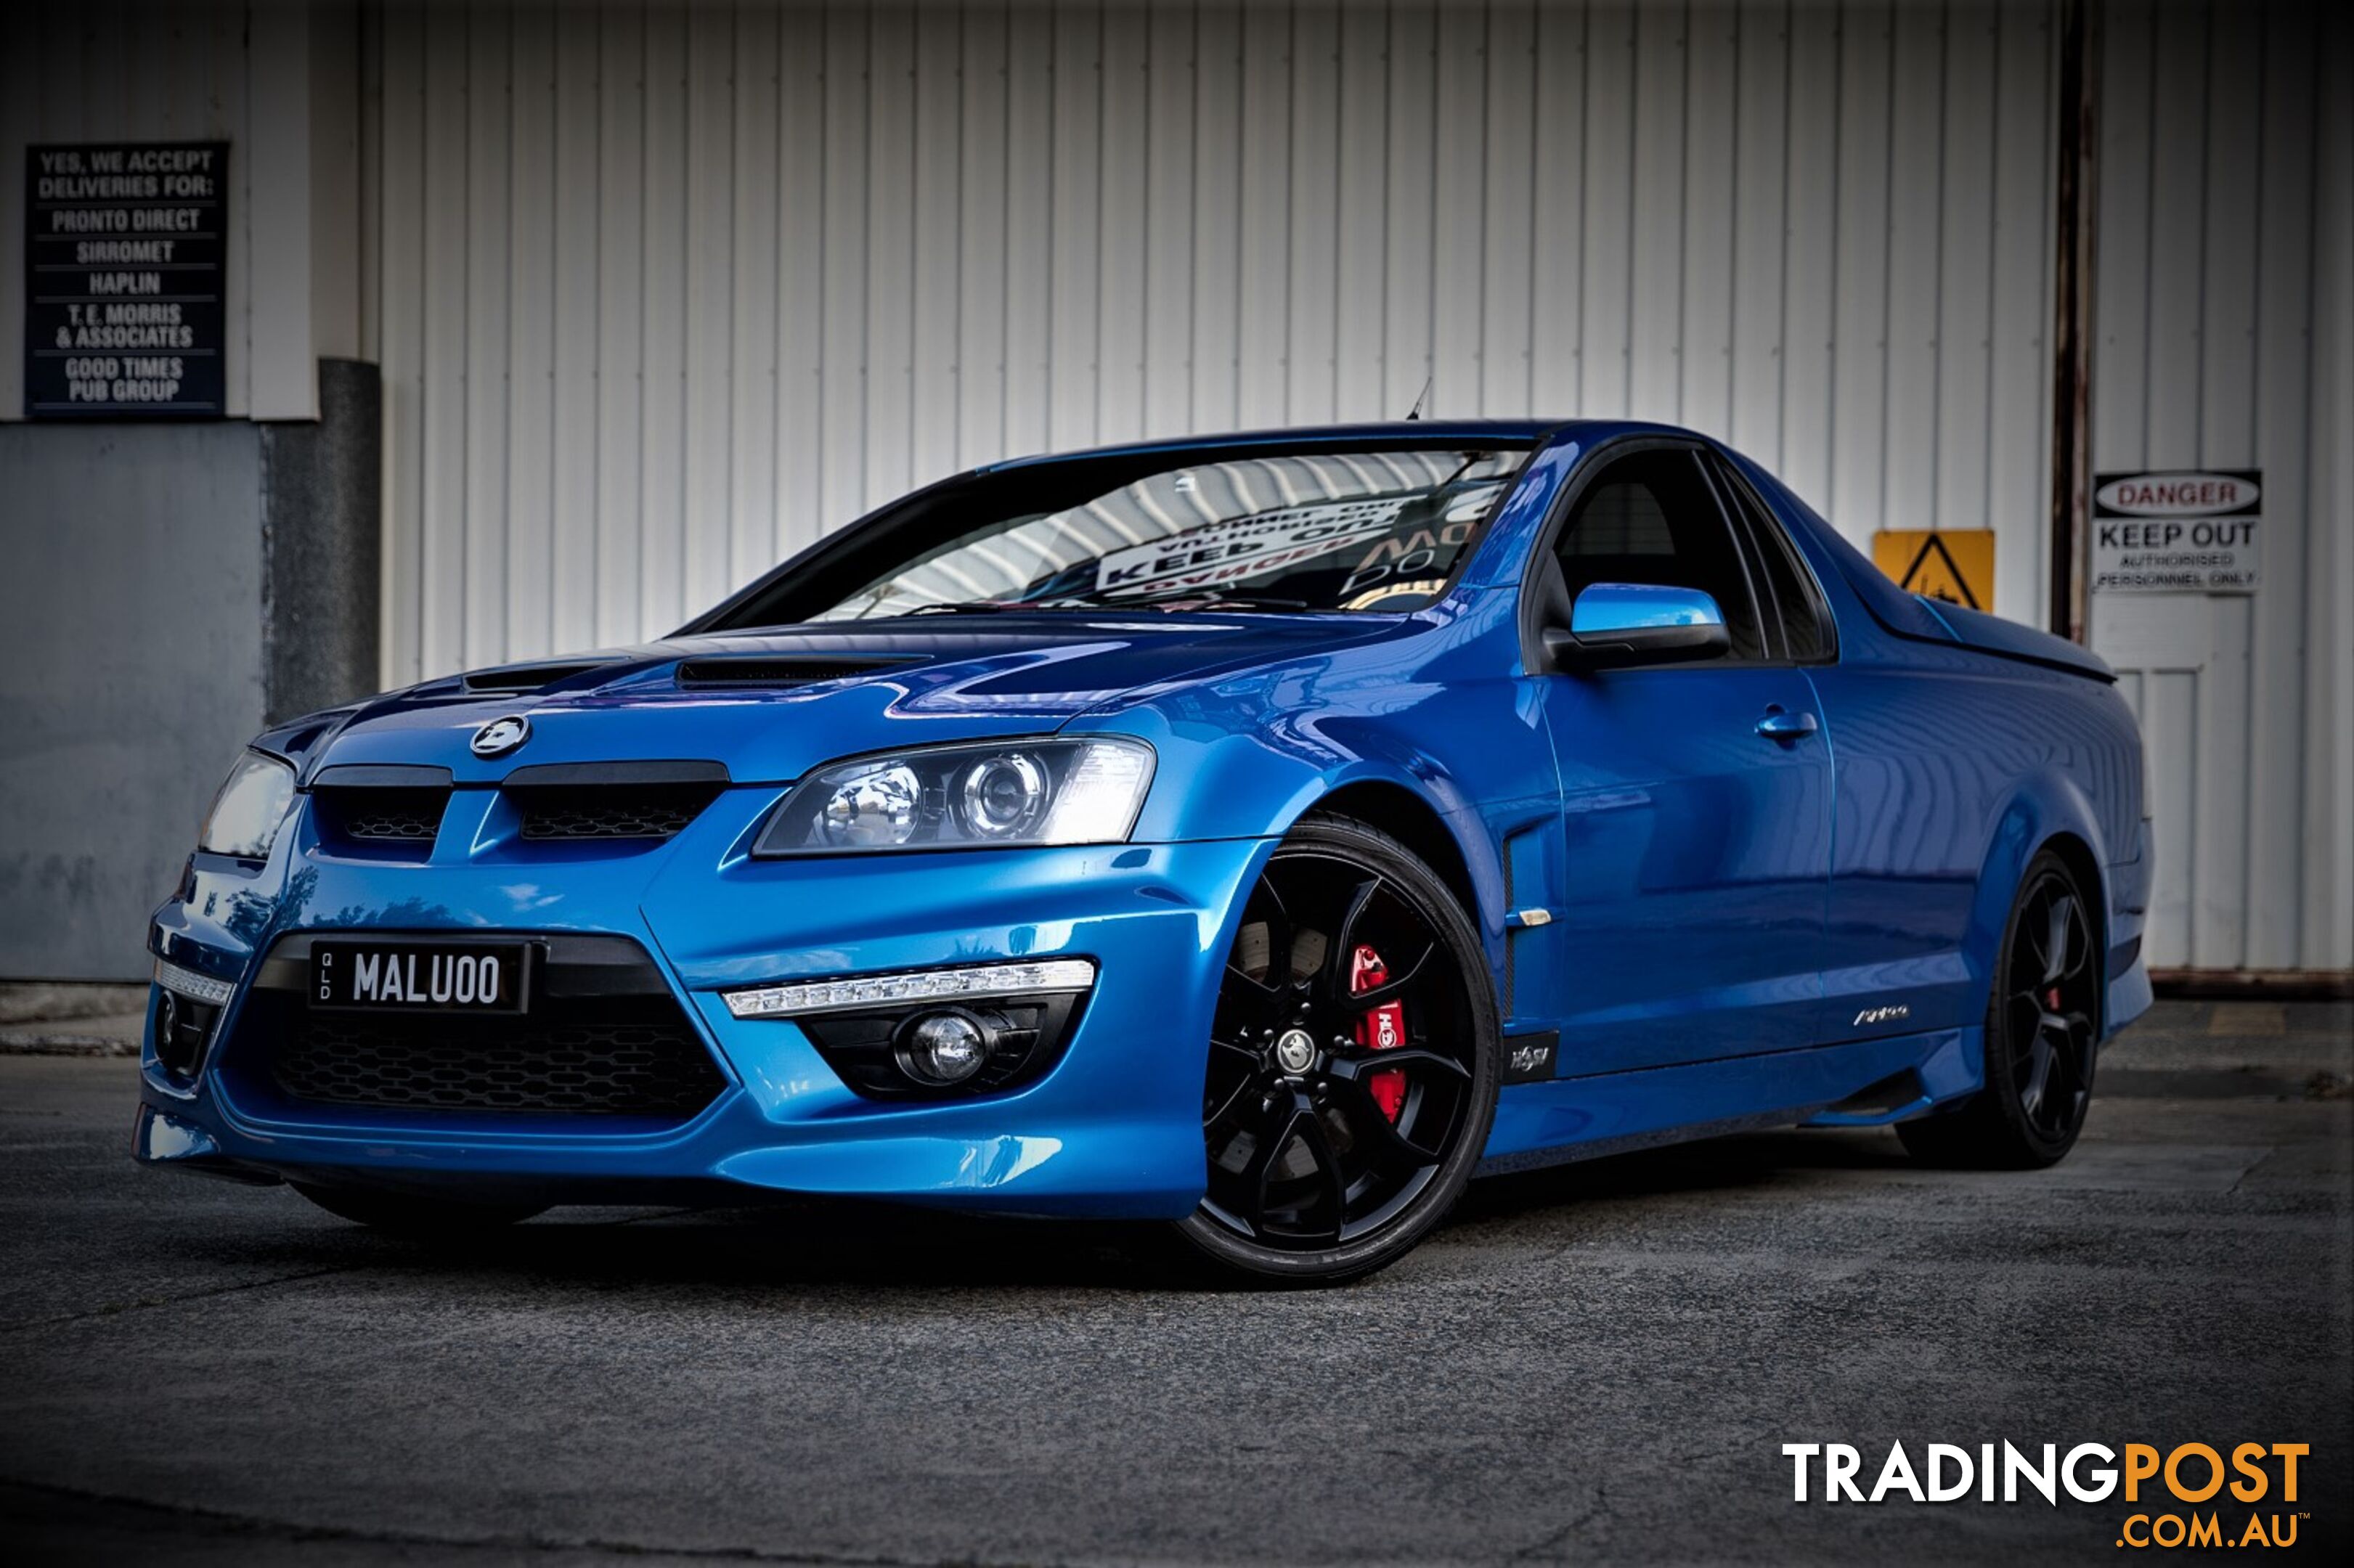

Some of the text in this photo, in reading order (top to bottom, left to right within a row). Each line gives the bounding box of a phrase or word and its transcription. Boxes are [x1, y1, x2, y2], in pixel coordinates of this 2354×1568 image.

[40, 150, 213, 174] YES, WE ACCEPT
[38, 175, 213, 198] DELIVERIES FOR:
[52, 208, 200, 232] PRONTO DIRECT
[76, 240, 174, 264] SIRROMET
[89, 271, 160, 295] HAPLIN
[105, 303, 182, 325] MORRIS
[56, 326, 193, 348] & ASSOCIATES
[65, 357, 183, 380] GOOD TIMES
[69, 380, 179, 401] PUB GROUP
[2118, 483, 2237, 505] DANGER
[2100, 522, 2256, 547] KEEP OUT
[2119, 553, 2234, 568] AUTHORISED
[2209, 571, 2255, 586] ONLY
